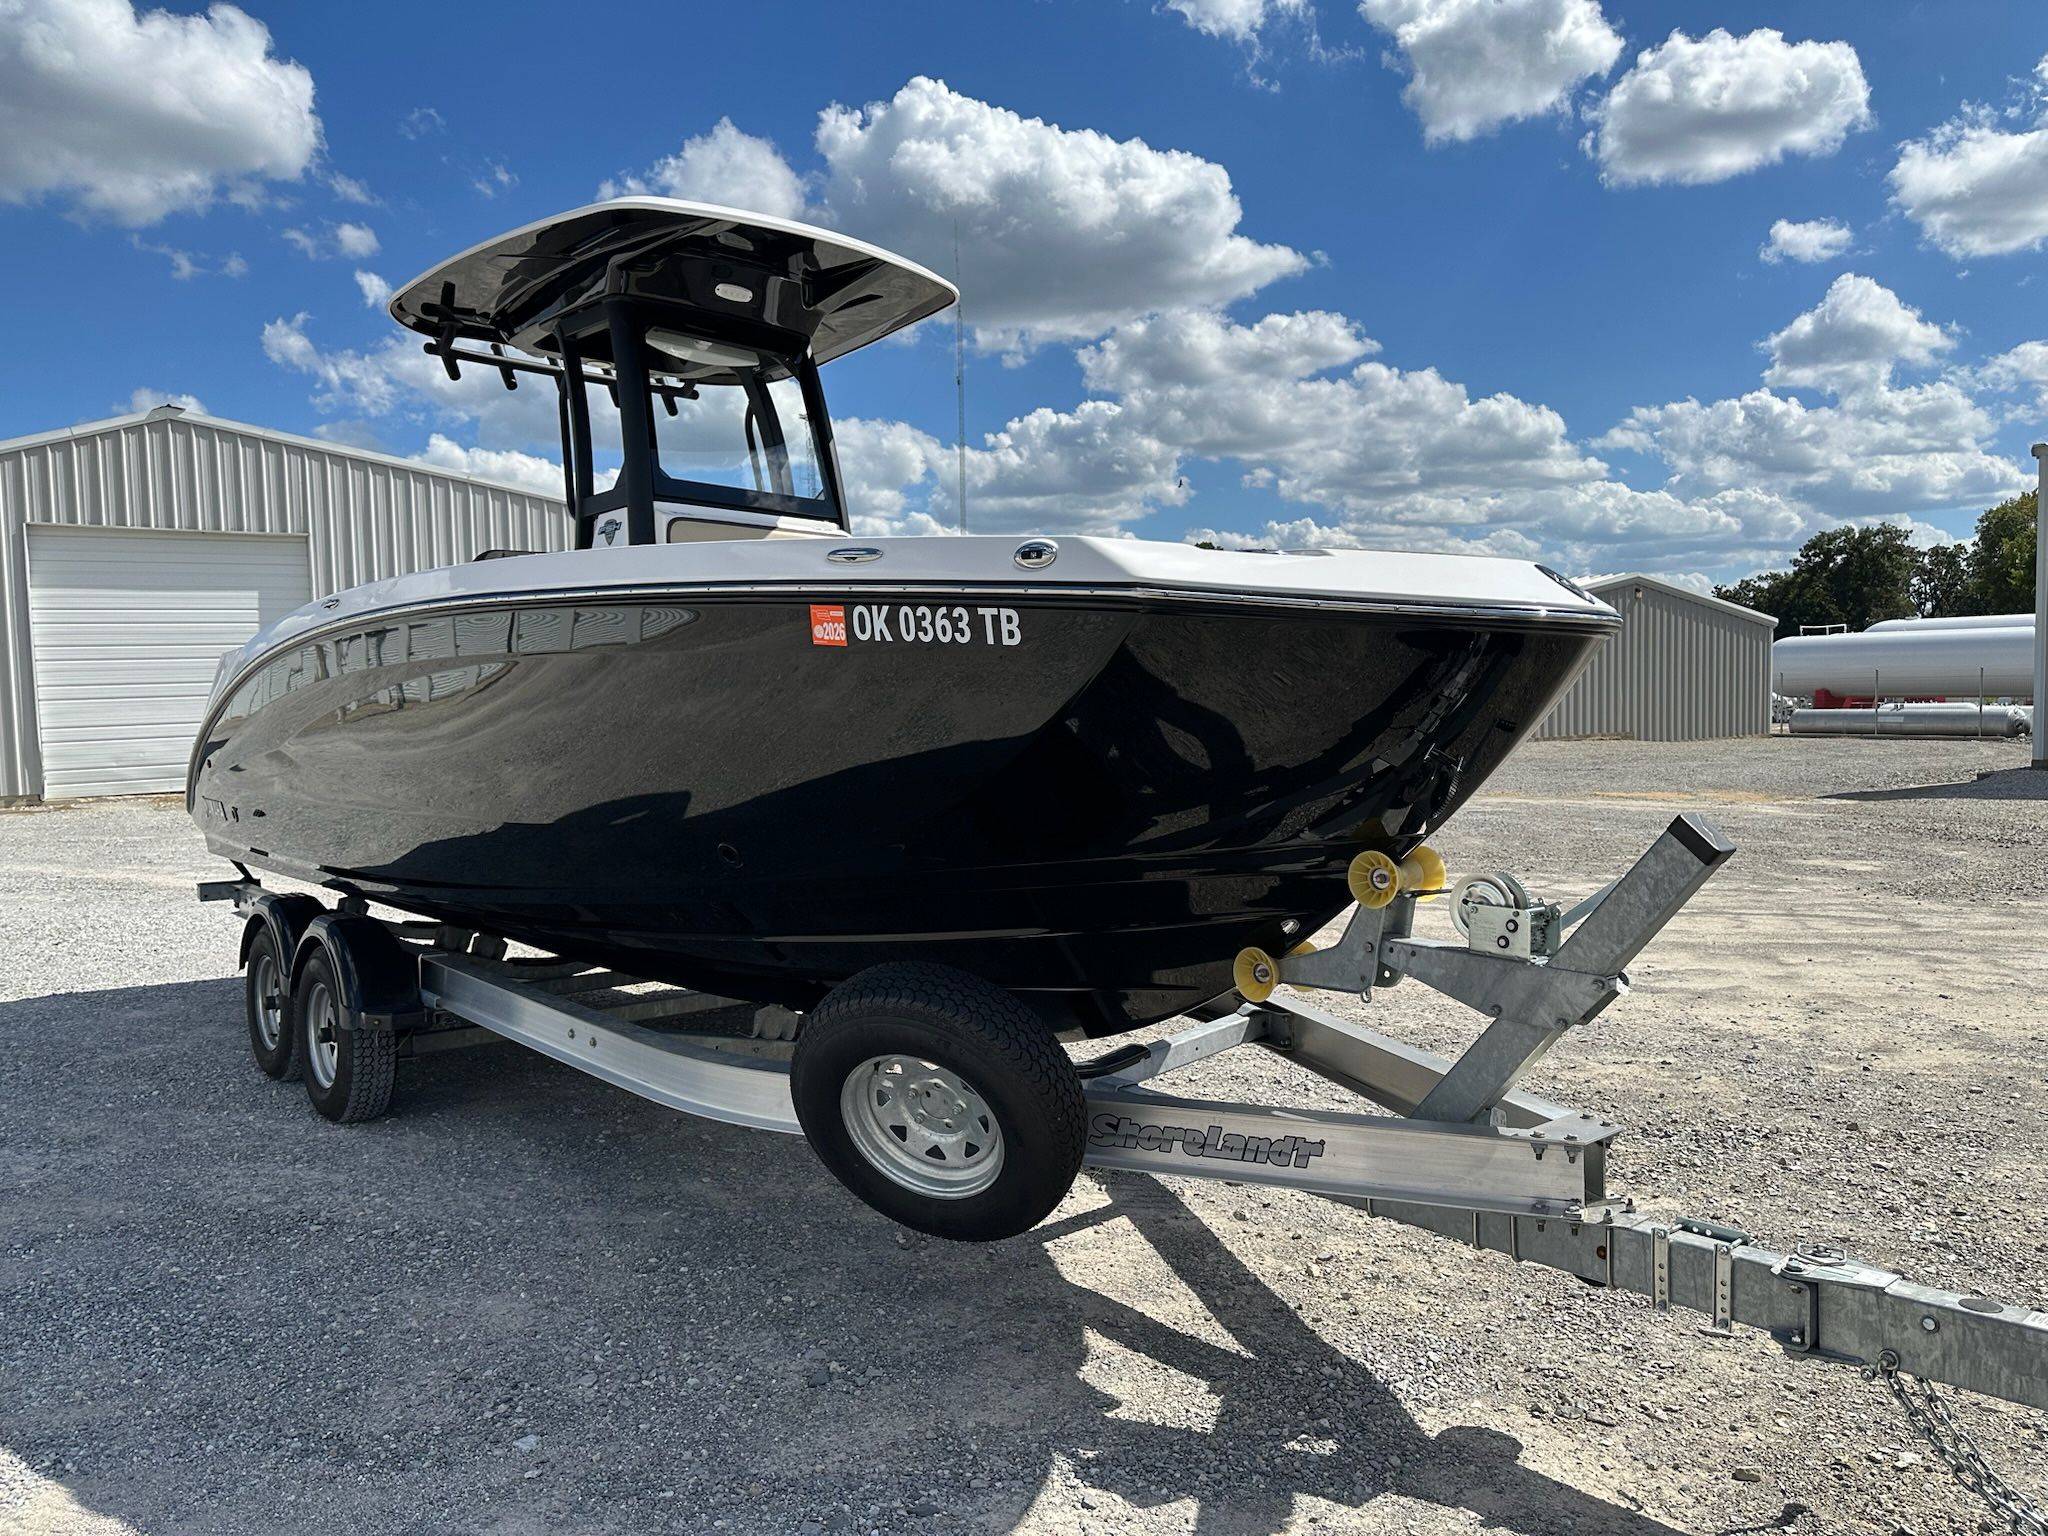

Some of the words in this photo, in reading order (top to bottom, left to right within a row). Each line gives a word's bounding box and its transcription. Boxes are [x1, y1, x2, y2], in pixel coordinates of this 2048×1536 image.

[823, 622, 846, 641] 2026
[853, 605, 893, 642] OK
[899, 606, 971, 644] 0363
[977, 607, 1022, 646] TB
